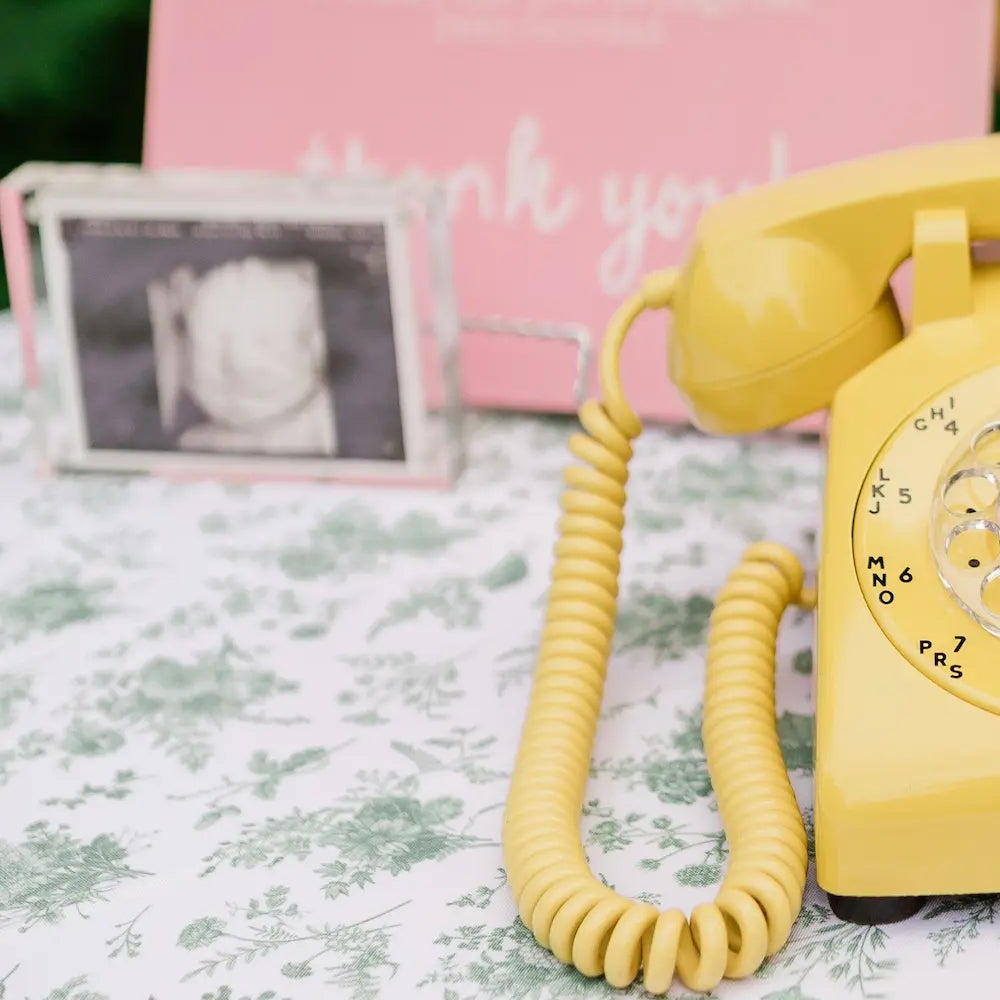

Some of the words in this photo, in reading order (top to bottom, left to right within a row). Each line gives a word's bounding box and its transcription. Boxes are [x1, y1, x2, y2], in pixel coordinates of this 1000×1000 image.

[944, 420, 959, 435] 4
[898, 488, 912, 504] 5
[898, 567, 913, 583] 6
[953, 636, 966, 653] 7
